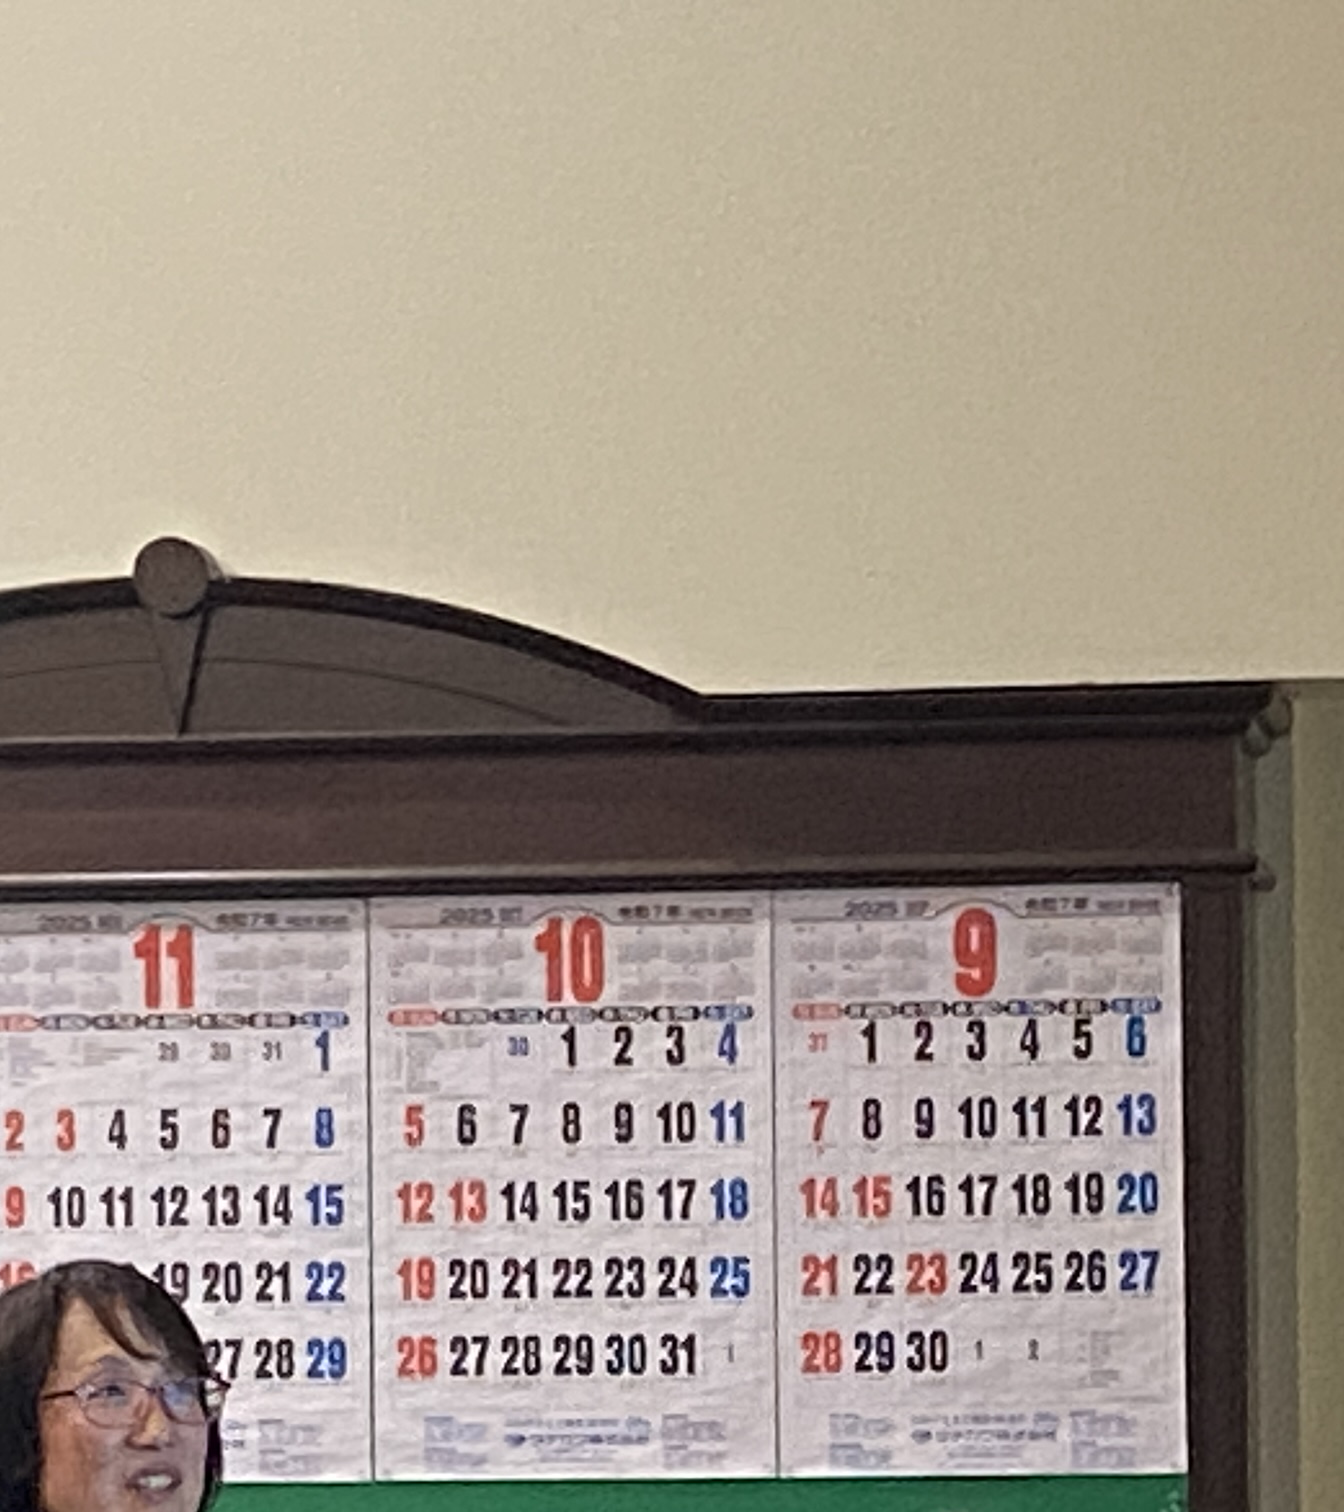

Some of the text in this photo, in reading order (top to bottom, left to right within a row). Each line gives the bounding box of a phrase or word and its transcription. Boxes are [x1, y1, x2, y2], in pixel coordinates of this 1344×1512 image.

[133, 923, 195, 1009] 11
[534, 915, 604, 1003] 10
[952, 907, 998, 997] 9
[261, 1040, 281, 1061] 31
[314, 1029, 330, 1072] 1
[560, 1024, 577, 1068] 1
[613, 1025, 634, 1067] 2
[665, 1024, 686, 1066] 3
[717, 1021, 739, 1065] 4
[860, 1018, 877, 1064] 1
[914, 1018, 934, 1062] 2
[966, 1018, 987, 1062] 3
[1019, 1017, 1040, 1061] 4
[1073, 1018, 1093, 1060] 5
[1125, 1015, 1147, 1058] 6
[4, 1107, 335, 1152] 2 3 4 5 6 7 8
[404, 1099, 745, 1149] 5 6 7 8 9 10 11
[808, 1093, 1157, 1143] 7 8 9 10 11 12 13
[5, 1183, 344, 1229] 9 10 11 12 13 14 15
[396, 1177, 749, 1224] 12 13 14 15 16 17 18
[799, 1171, 1159, 1219] 14 15 16 17 18 19 20
[202, 1261, 243, 1304] 20
[255, 1260, 291, 1303] 21
[305, 1260, 346, 1303] 22
[396, 1256, 751, 1301] 19 20 21 22 23 24 25
[801, 1249, 1160, 1297] 21 22 23 24 25 26 27
[254, 1338, 295, 1380] 28
[306, 1337, 347, 1380] 29
[397, 1335, 438, 1380] 26
[449, 1335, 490, 1377] 27
[501, 1335, 542, 1377] 28
[553, 1334, 594, 1376] 29
[605, 1333, 647, 1376] 30
[659, 1333, 696, 1376] 31
[800, 1330, 843, 1374] 28
[854, 1330, 895, 1374] 29
[906, 1330, 949, 1373] 30
